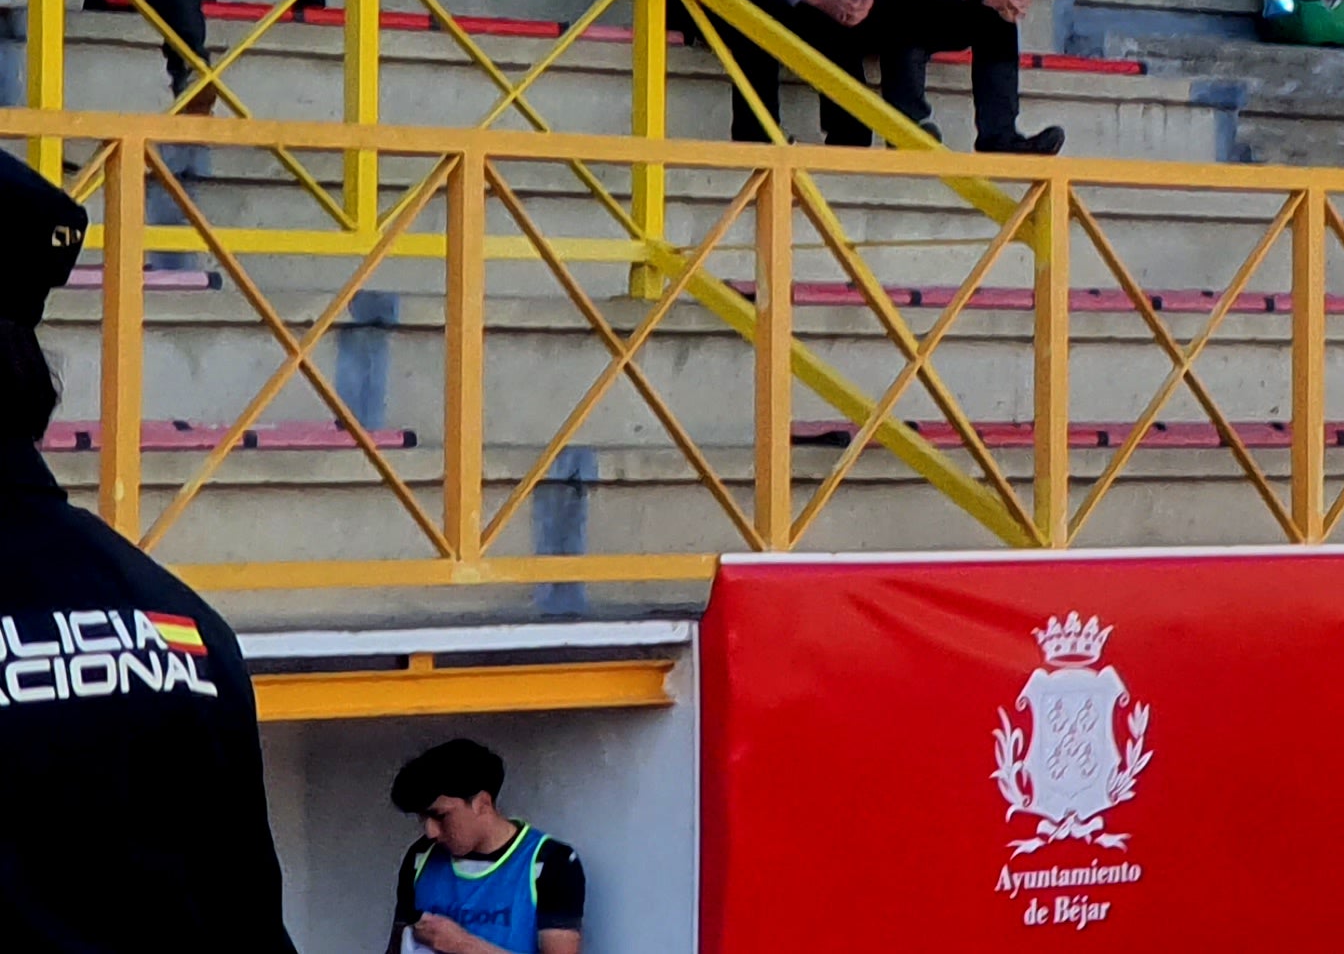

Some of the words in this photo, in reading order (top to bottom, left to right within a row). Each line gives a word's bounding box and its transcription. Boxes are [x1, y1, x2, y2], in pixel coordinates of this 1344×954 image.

[0, 609, 168, 661] LICIA
[994, 858, 1141, 899] Ayuntamiento
[1023, 897, 1049, 925] de
[1053, 894, 1111, 930] Béjar
